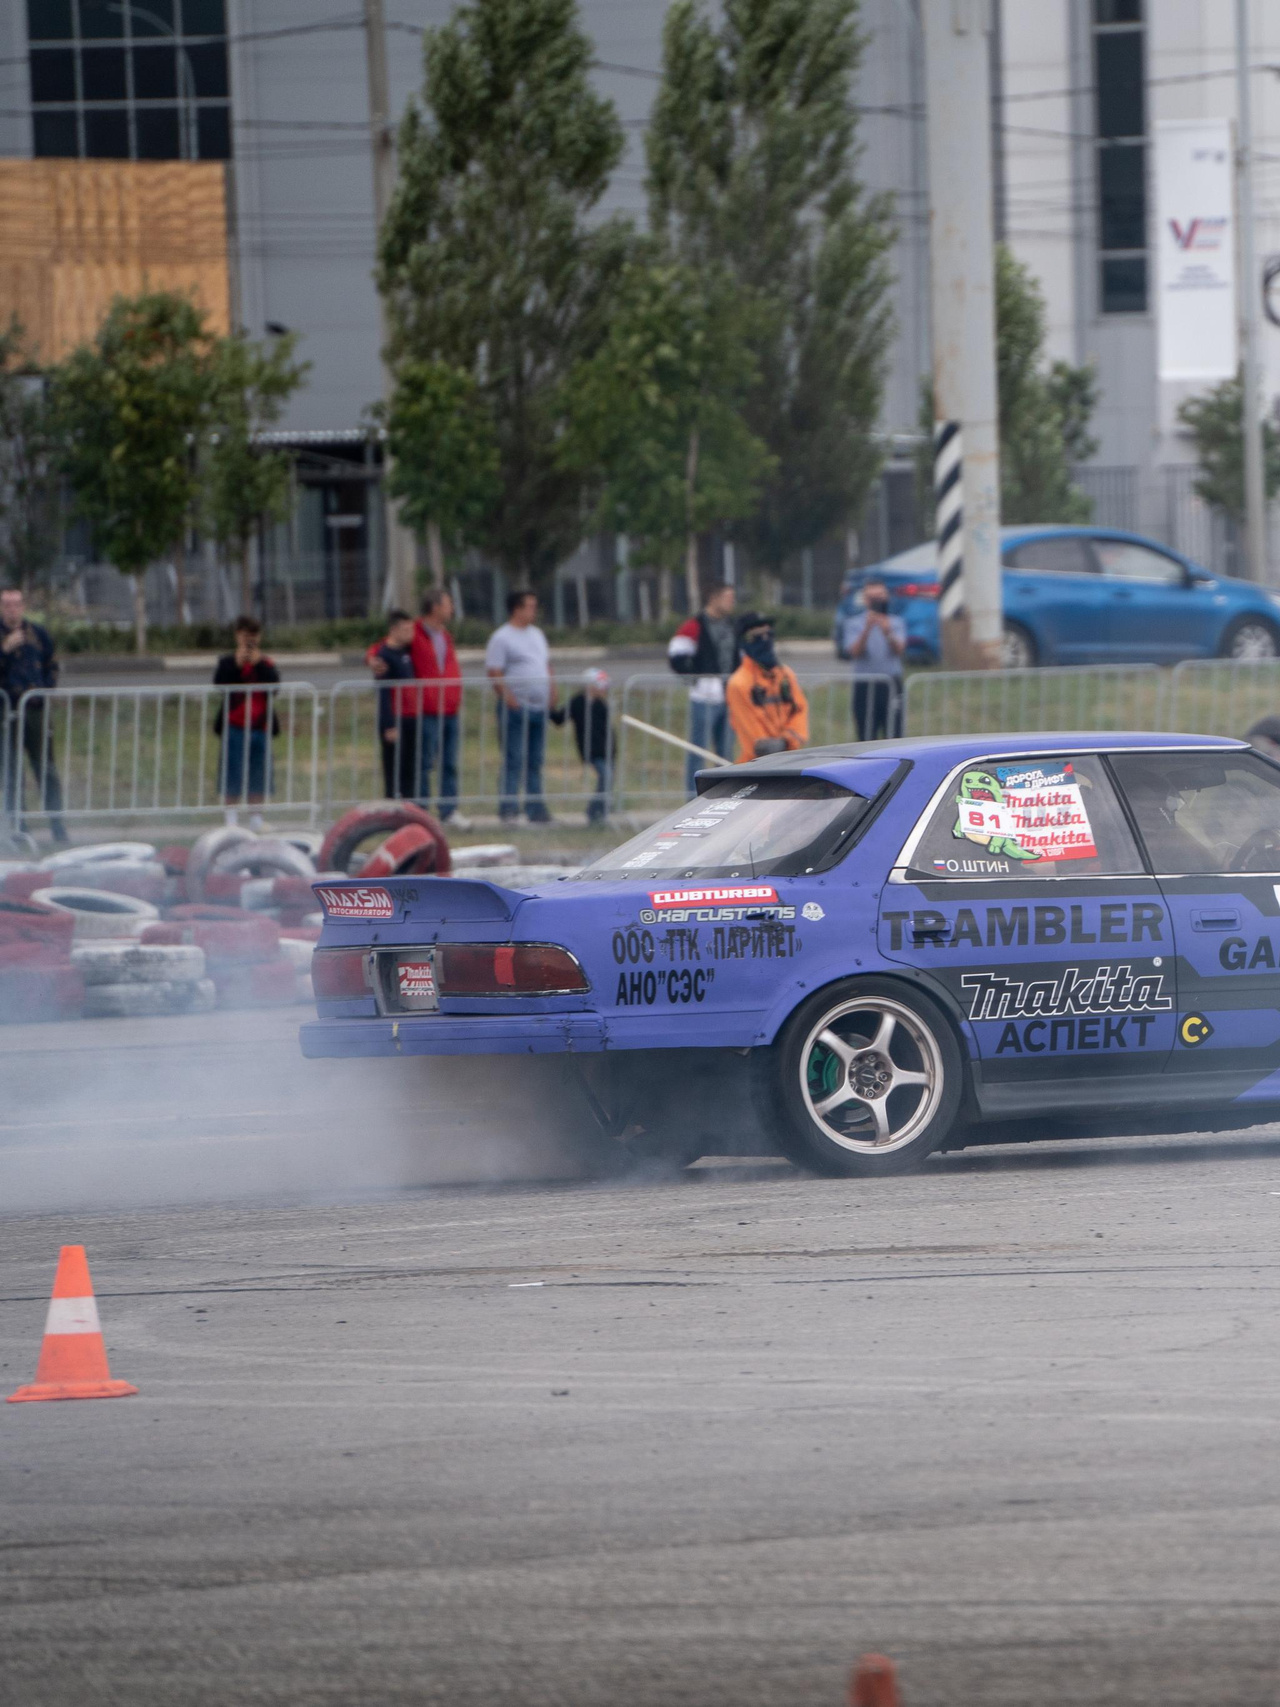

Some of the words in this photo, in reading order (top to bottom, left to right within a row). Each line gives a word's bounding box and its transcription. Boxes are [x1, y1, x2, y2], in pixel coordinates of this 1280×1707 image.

[1006, 769, 1043, 787] ДОРОГА
[1031, 773, 1066, 789] ДРИФТ
[968, 811, 1001, 829] 81
[946, 859, 1010, 873] О.ШТИН
[654, 887, 773, 904] CLUBTURBO
[882, 902, 1165, 951] TRAMBLER
[612, 929, 655, 964] ООО
[995, 1015, 1155, 1054] АСПЕКТ
